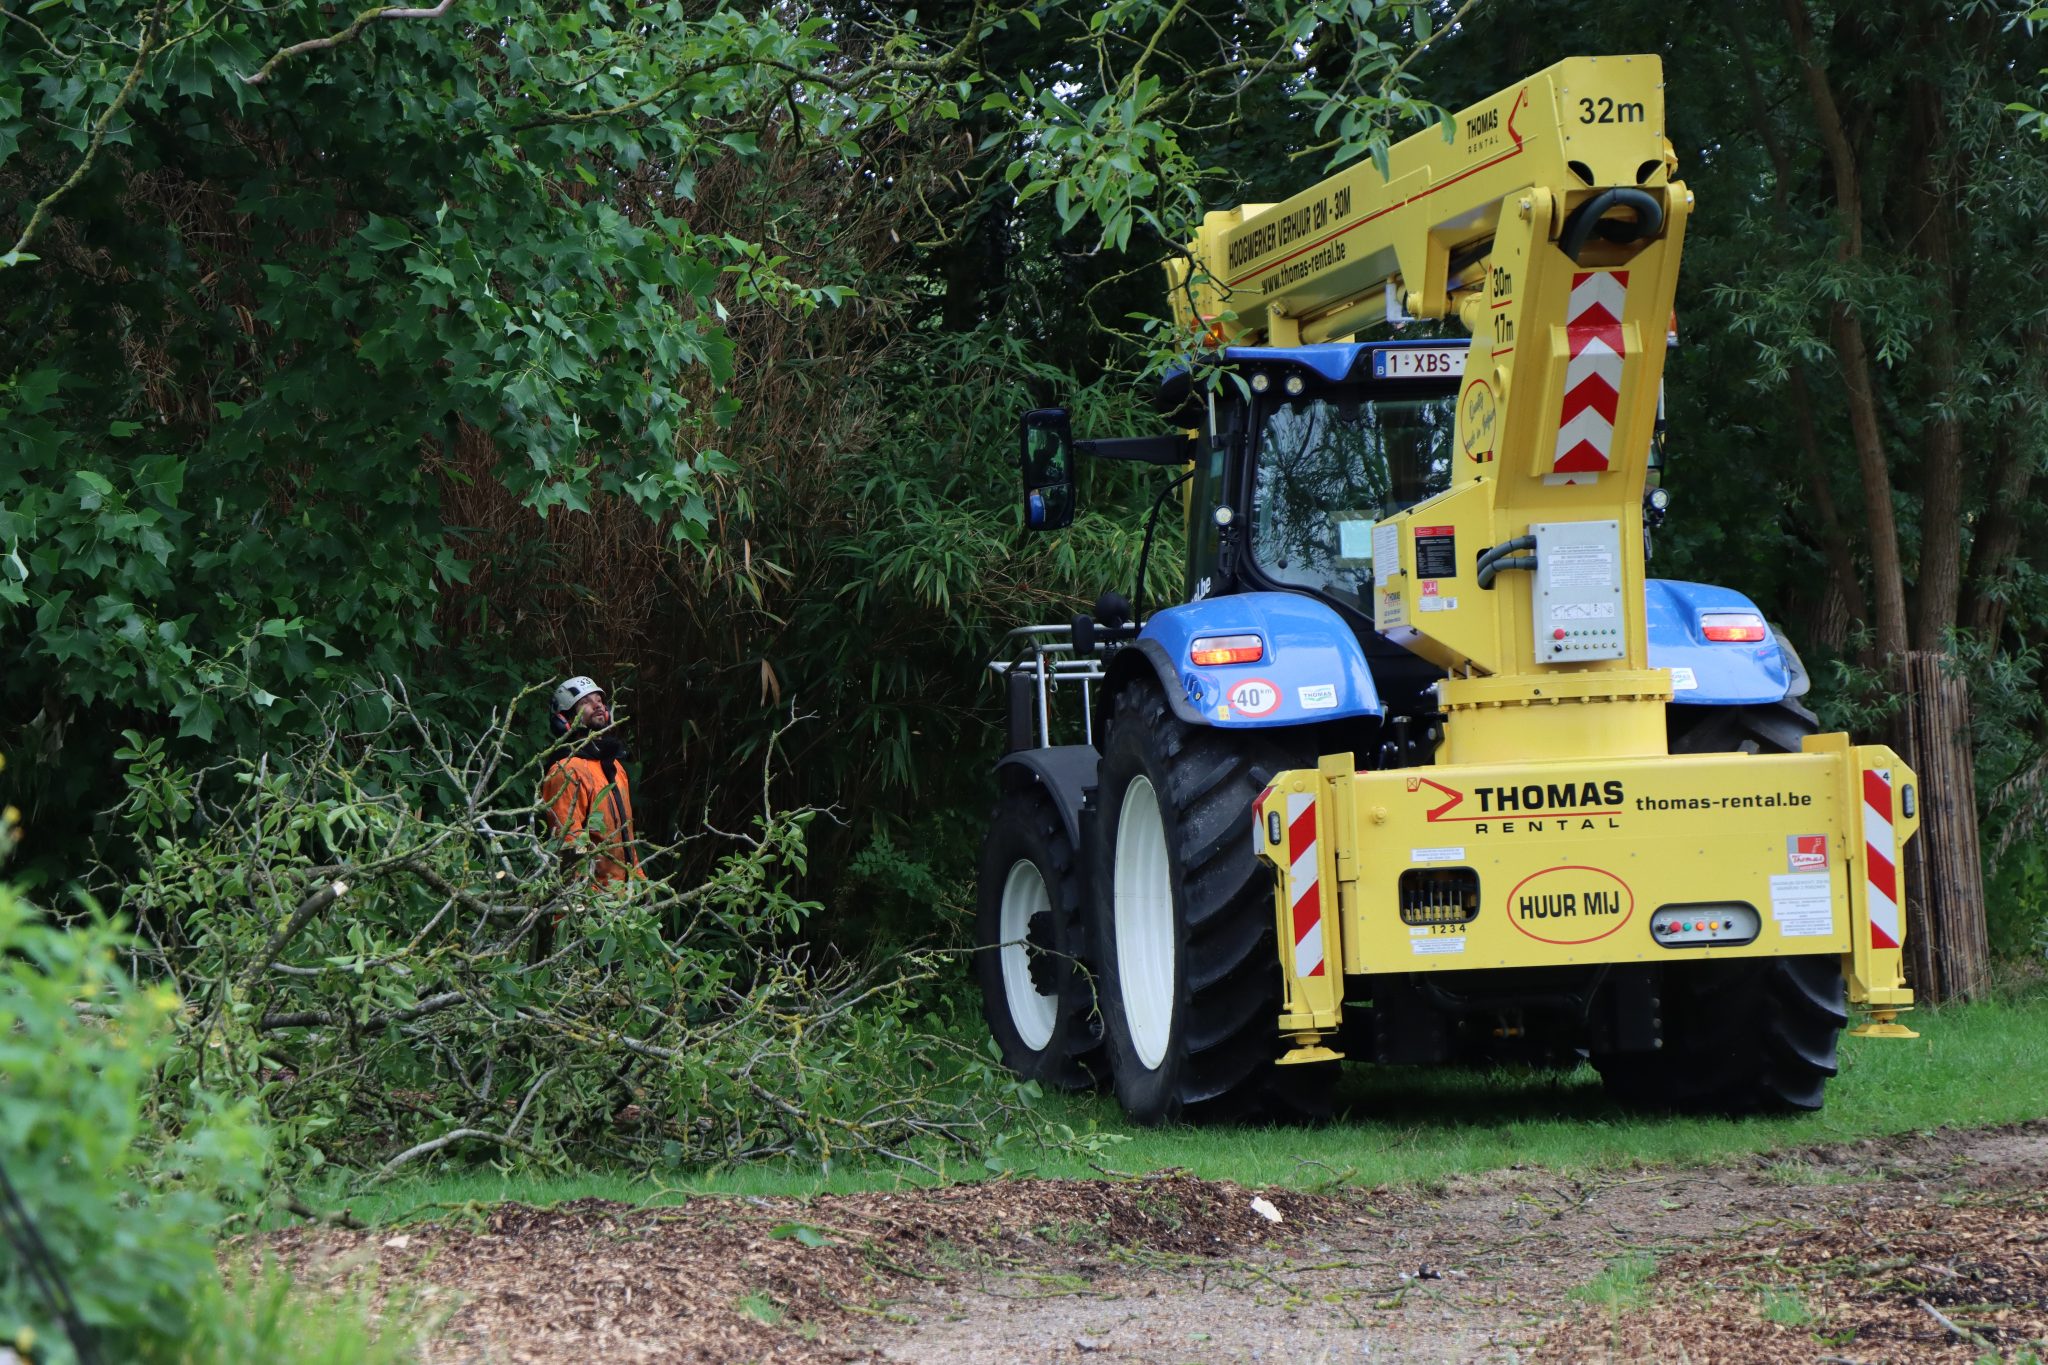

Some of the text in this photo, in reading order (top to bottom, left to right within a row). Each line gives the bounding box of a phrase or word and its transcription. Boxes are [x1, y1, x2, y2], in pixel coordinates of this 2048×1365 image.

[1467, 108, 1498, 140] THOMAS
[1579, 97, 1645, 125] 32m
[1468, 139, 1499, 155] RENTAL
[1229, 222, 1276, 270] HOOGWERKER
[1278, 206, 1311, 247] VERHUUR
[1313, 198, 1328, 230] 12M
[1334, 185, 1351, 221] 30M
[1261, 240, 1346, 296] www.thomas-rental.be
[1493, 266, 1512, 298] 30m
[1494, 313, 1514, 344] 17m
[1377, 366, 1384, 374] B
[1390, 352, 1468, 373] 1-XBS-
[1237, 688, 1260, 707] 40
[1883, 772, 1890, 781] 4
[1475, 780, 1624, 812] THOMAS
[1636, 792, 1812, 811] thomas-rental.be
[1475, 818, 1619, 834] RENTAL
[1520, 890, 1620, 919] HUUR MIJ
